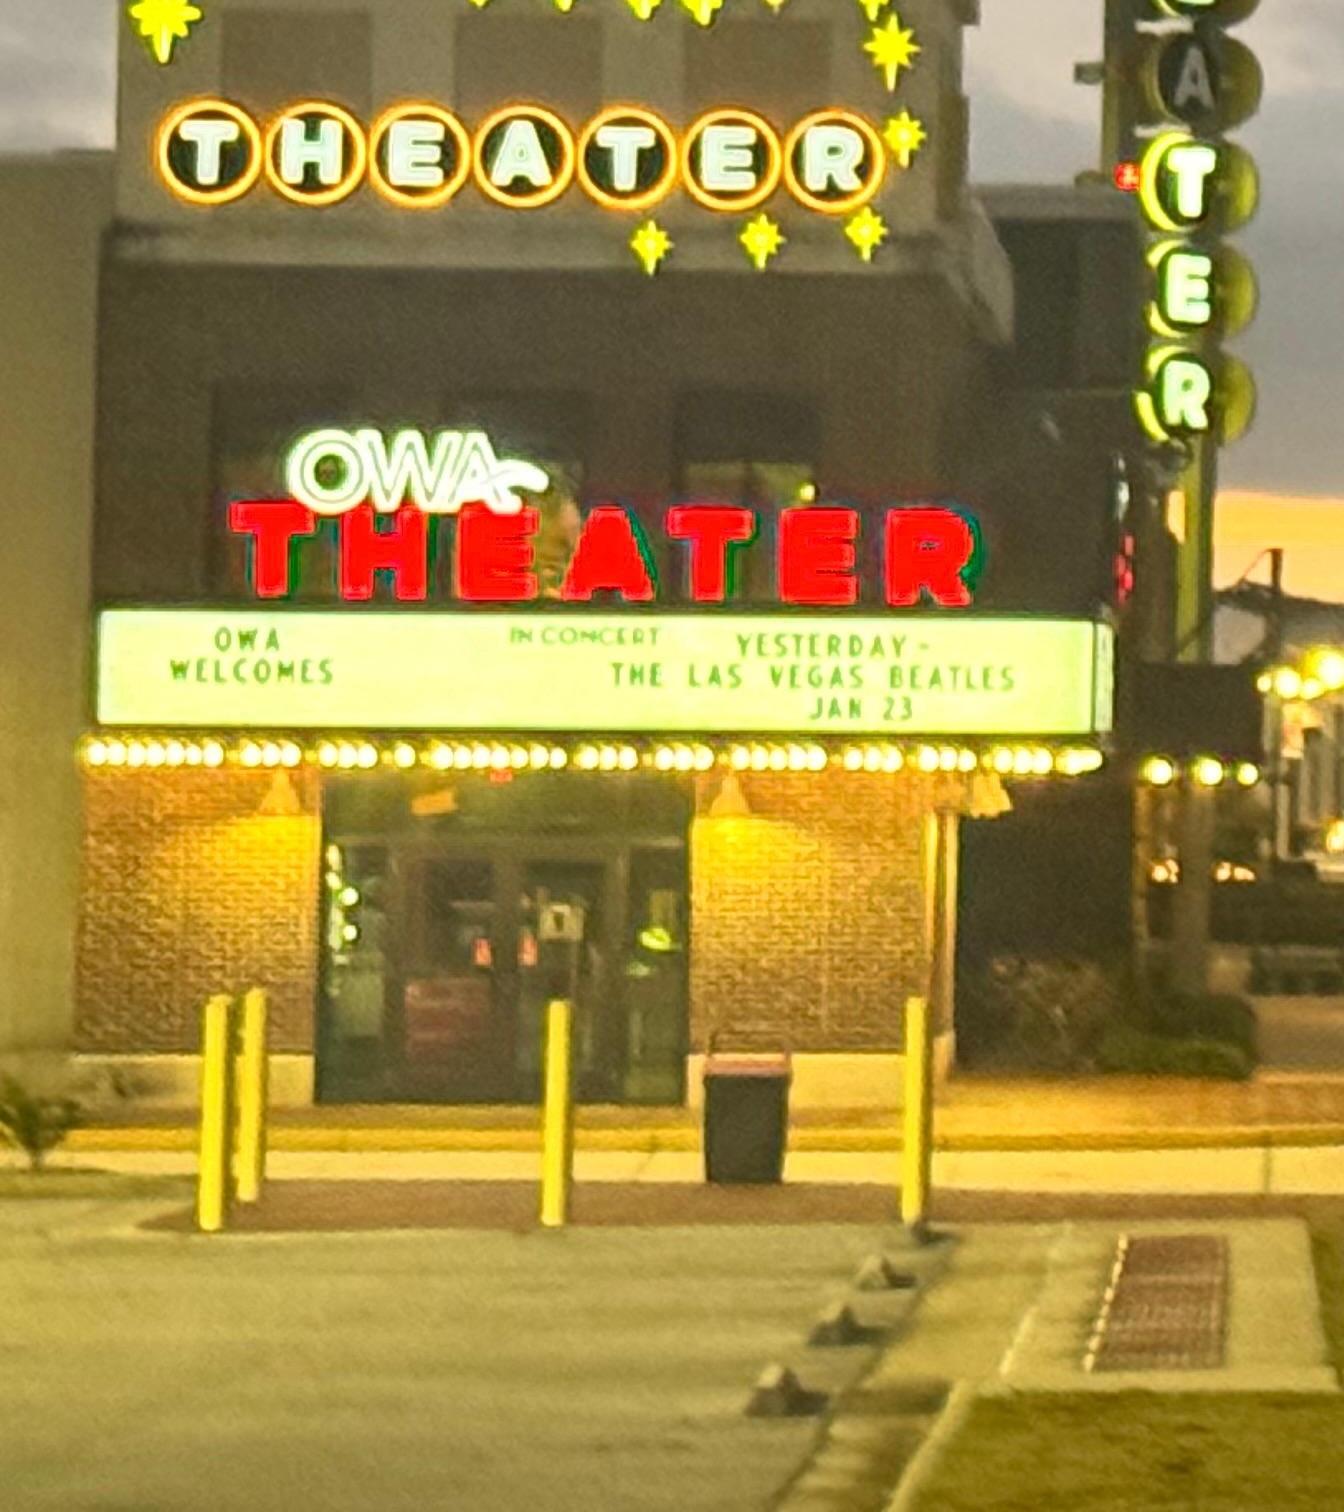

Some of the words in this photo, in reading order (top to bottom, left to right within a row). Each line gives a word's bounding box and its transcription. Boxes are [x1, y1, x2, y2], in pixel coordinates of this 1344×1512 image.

[179, 120, 865, 193] THEATER
[285, 427, 551, 516] OWA
[228, 499, 976, 606] THEATER
[213, 626, 280, 652] OWA
[509, 626, 533, 645] IN
[541, 626, 662, 646] CONCERT
[169, 657, 334, 685] WELCOMES
[611, 662, 664, 687] THE
[688, 663, 743, 689] LAS
[769, 664, 864, 690] VEGAS
[889, 664, 1015, 691] BEATLES
[808, 696, 862, 720] JAN
[883, 696, 913, 721] 23
